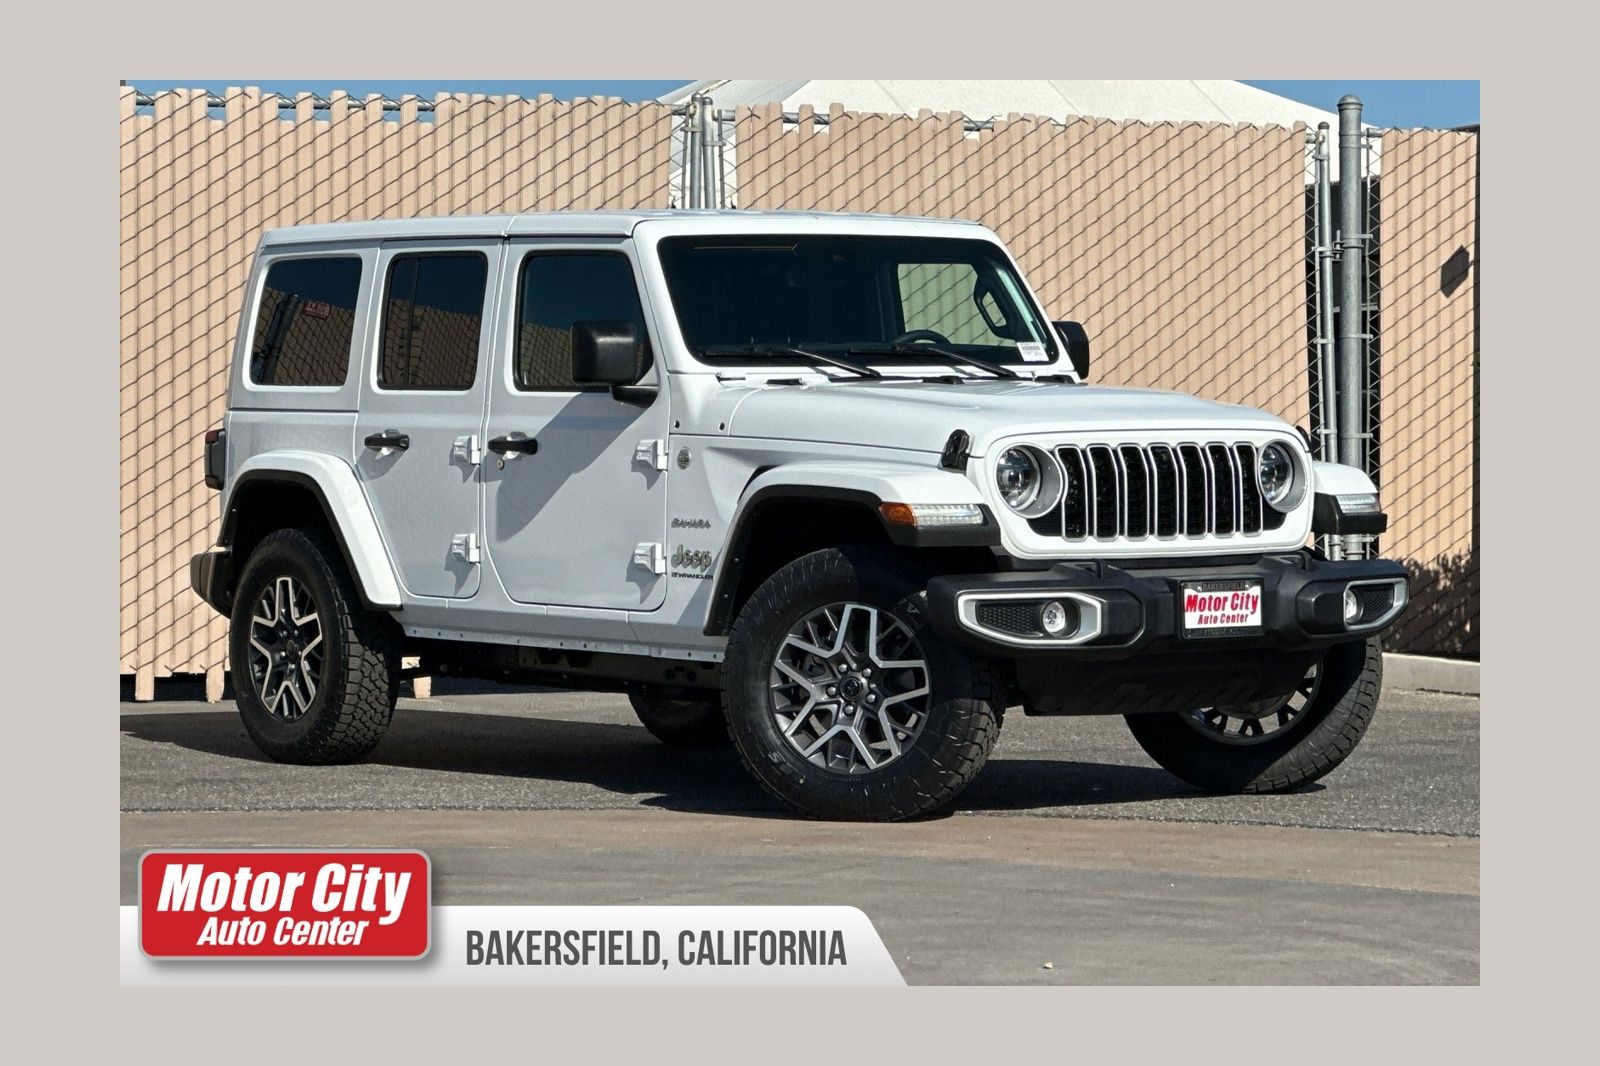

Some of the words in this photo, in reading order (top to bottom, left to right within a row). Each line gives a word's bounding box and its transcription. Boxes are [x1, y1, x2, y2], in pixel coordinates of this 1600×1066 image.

[671, 544, 712, 573] Jeep
[1202, 582, 1245, 591] BAKERSFIELD
[1185, 594, 1228, 612] Motor
[1230, 592, 1259, 615] City
[1198, 614, 1218, 625] Auto
[1220, 613, 1249, 624] Center
